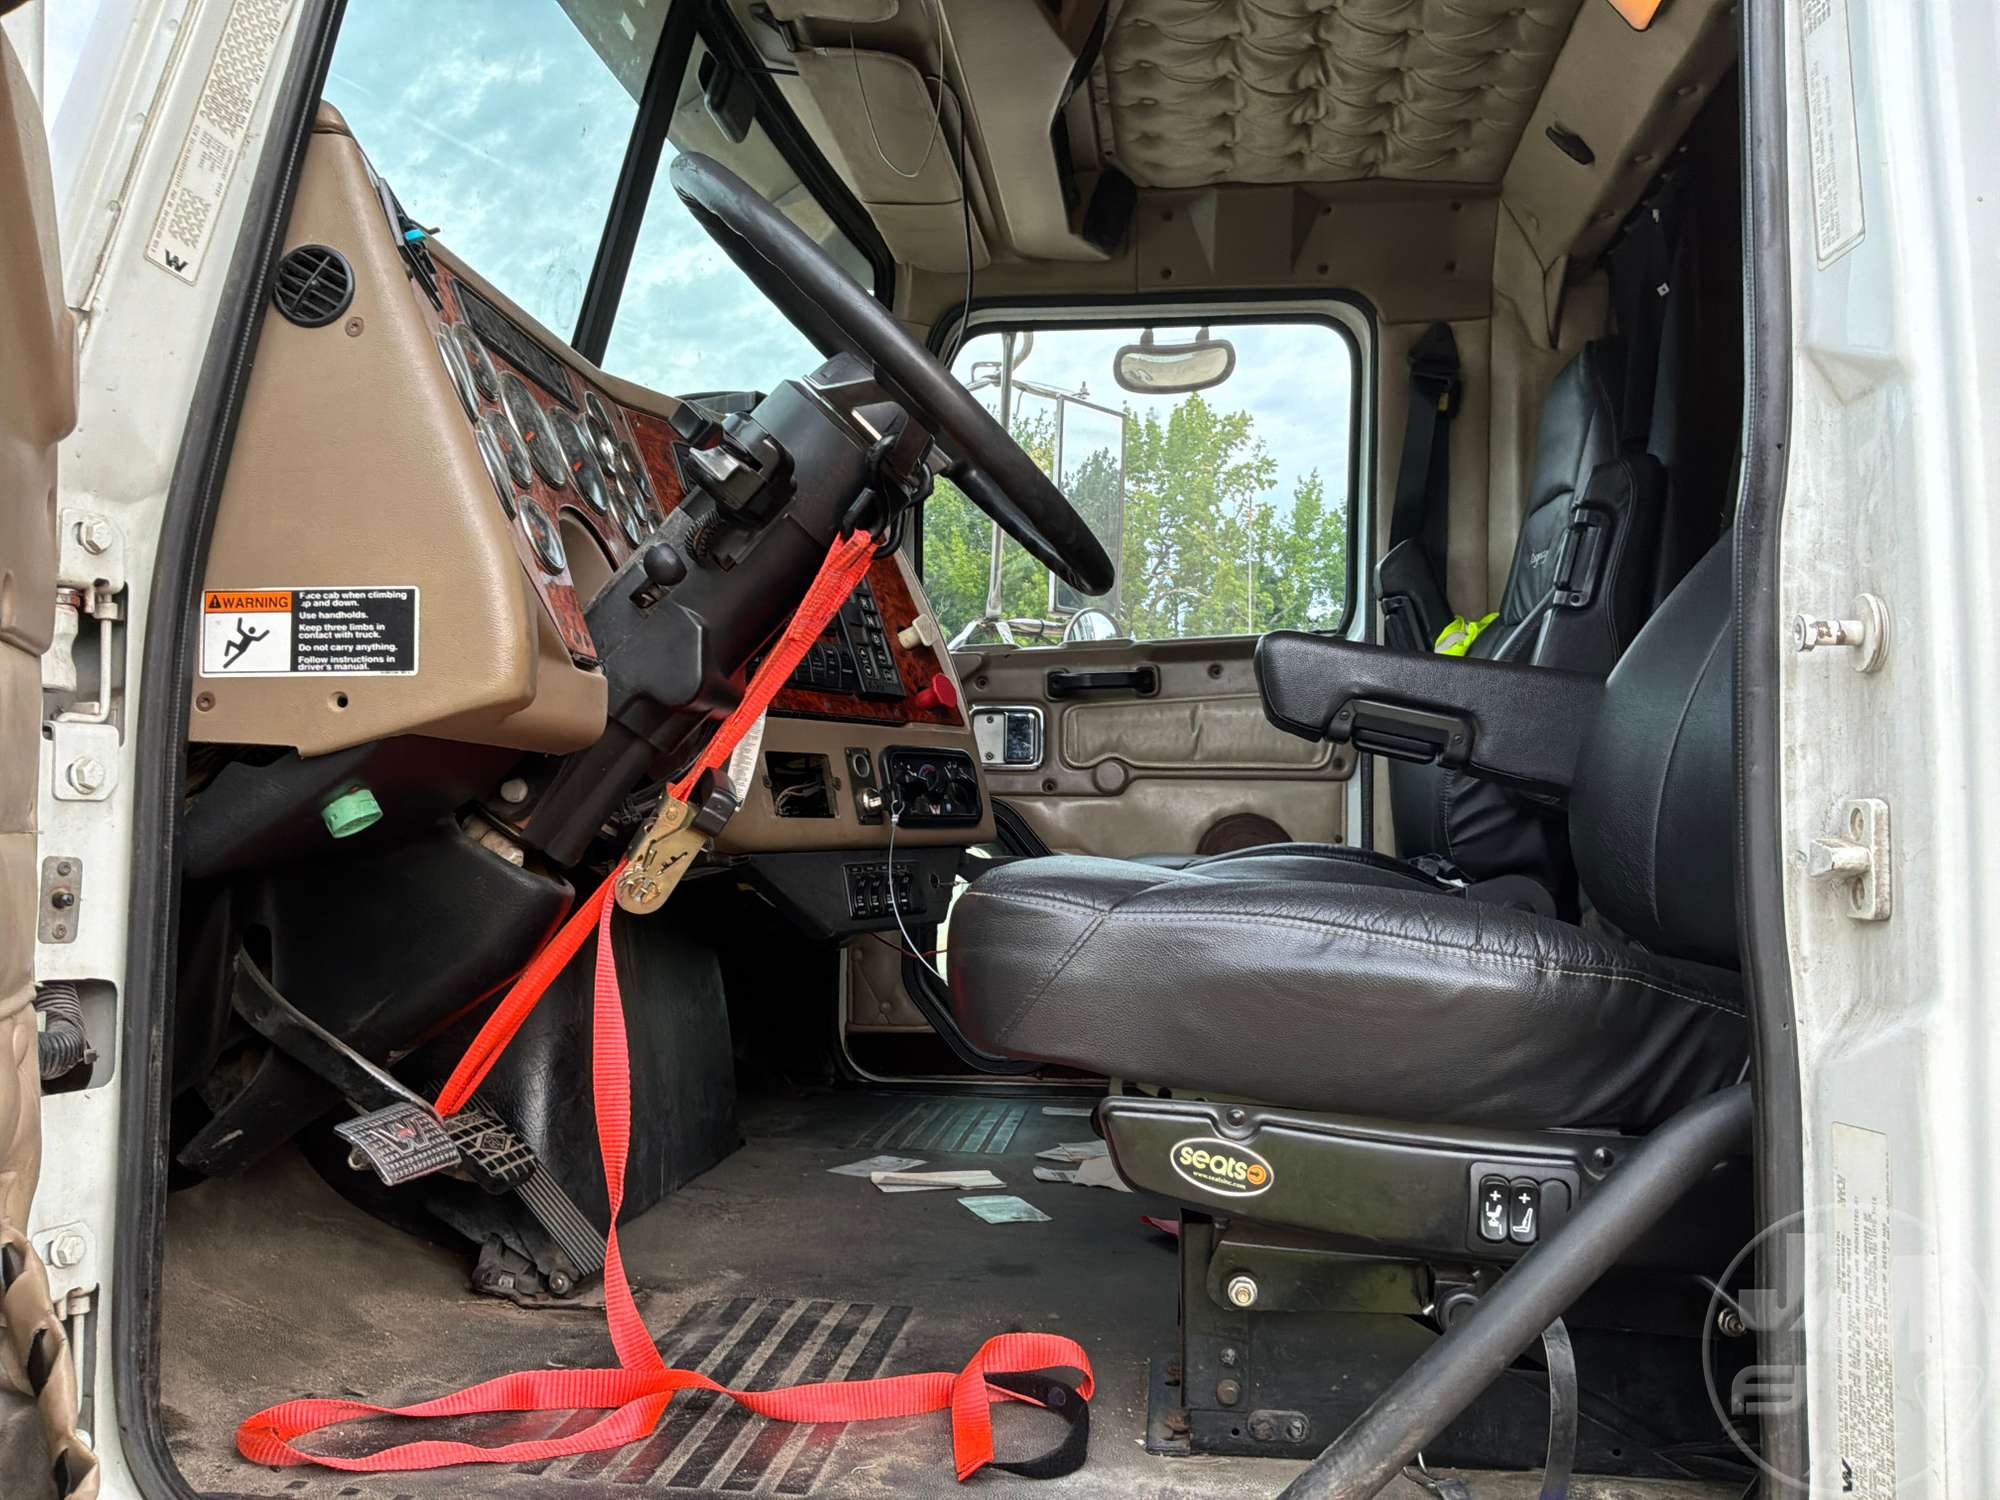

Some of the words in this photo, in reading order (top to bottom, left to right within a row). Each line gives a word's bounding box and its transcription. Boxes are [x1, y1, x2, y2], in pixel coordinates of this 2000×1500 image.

[341, 591, 366, 599] when
[367, 591, 408, 601] climbing
[222, 595, 289, 608] WARNING
[313, 599, 331, 607] and
[332, 599, 360, 607] down.
[318, 611, 369, 619] handholds.
[298, 624, 322, 633] Keep
[324, 623, 348, 631] three
[349, 623, 374, 631] limbs
[376, 623, 385, 631] in
[298, 631, 332, 639] contact
[334, 630, 354, 638] with
[355, 630, 381, 639] truck.
[298, 643, 311, 651] Do
[313, 643, 328, 651] not
[330, 644, 353, 652] carry
[355, 643, 398, 653] anything.
[298, 656, 328, 664] Follow
[330, 655, 384, 663] instructions
[386, 655, 395, 663] in
[297, 663, 332, 671] driver's
[334, 663, 370, 671] manual.
[1179, 1146, 1248, 1181] seats
